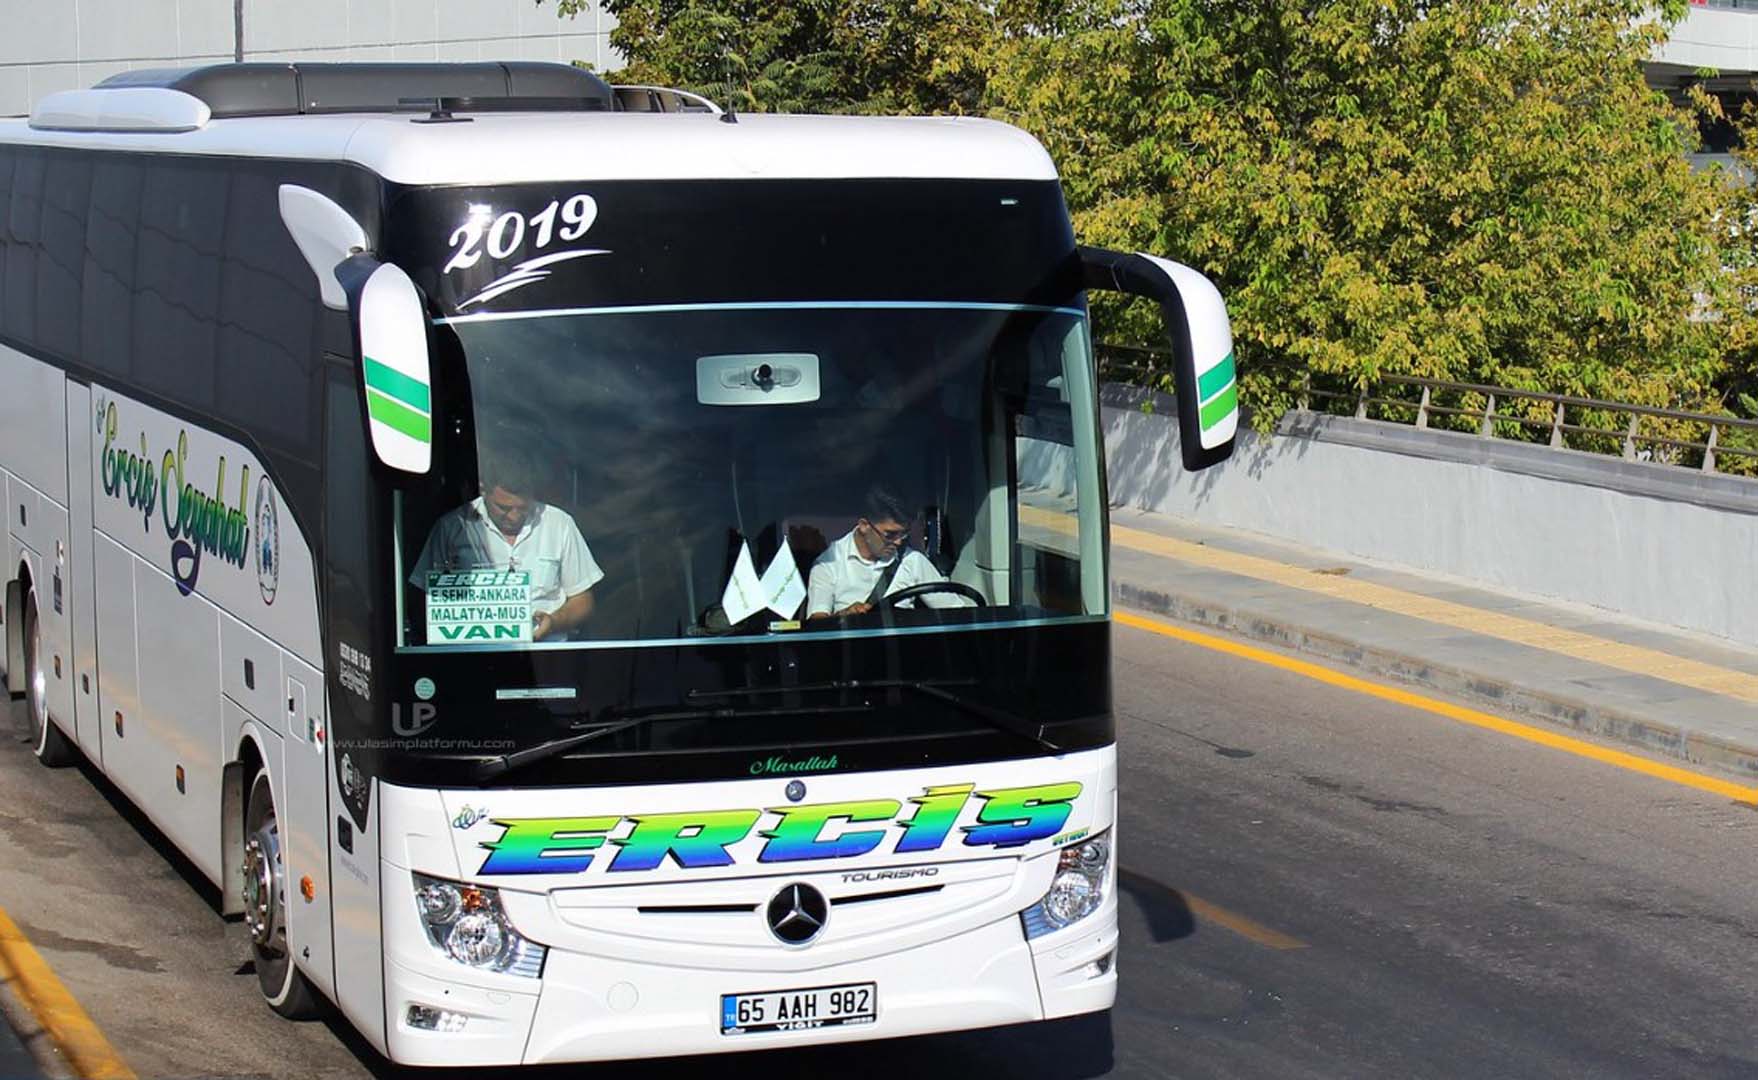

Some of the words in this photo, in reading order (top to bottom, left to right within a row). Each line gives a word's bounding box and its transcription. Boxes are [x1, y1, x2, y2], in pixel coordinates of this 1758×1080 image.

[443, 194, 598, 274] 2019
[161, 429, 250, 597] Seyahat
[438, 625, 520, 639] VAN
[841, 867, 939, 883] TOURISMO
[738, 999, 765, 1023] 65
[777, 994, 817, 1020] AAH
[830, 989, 869, 1015] 982
